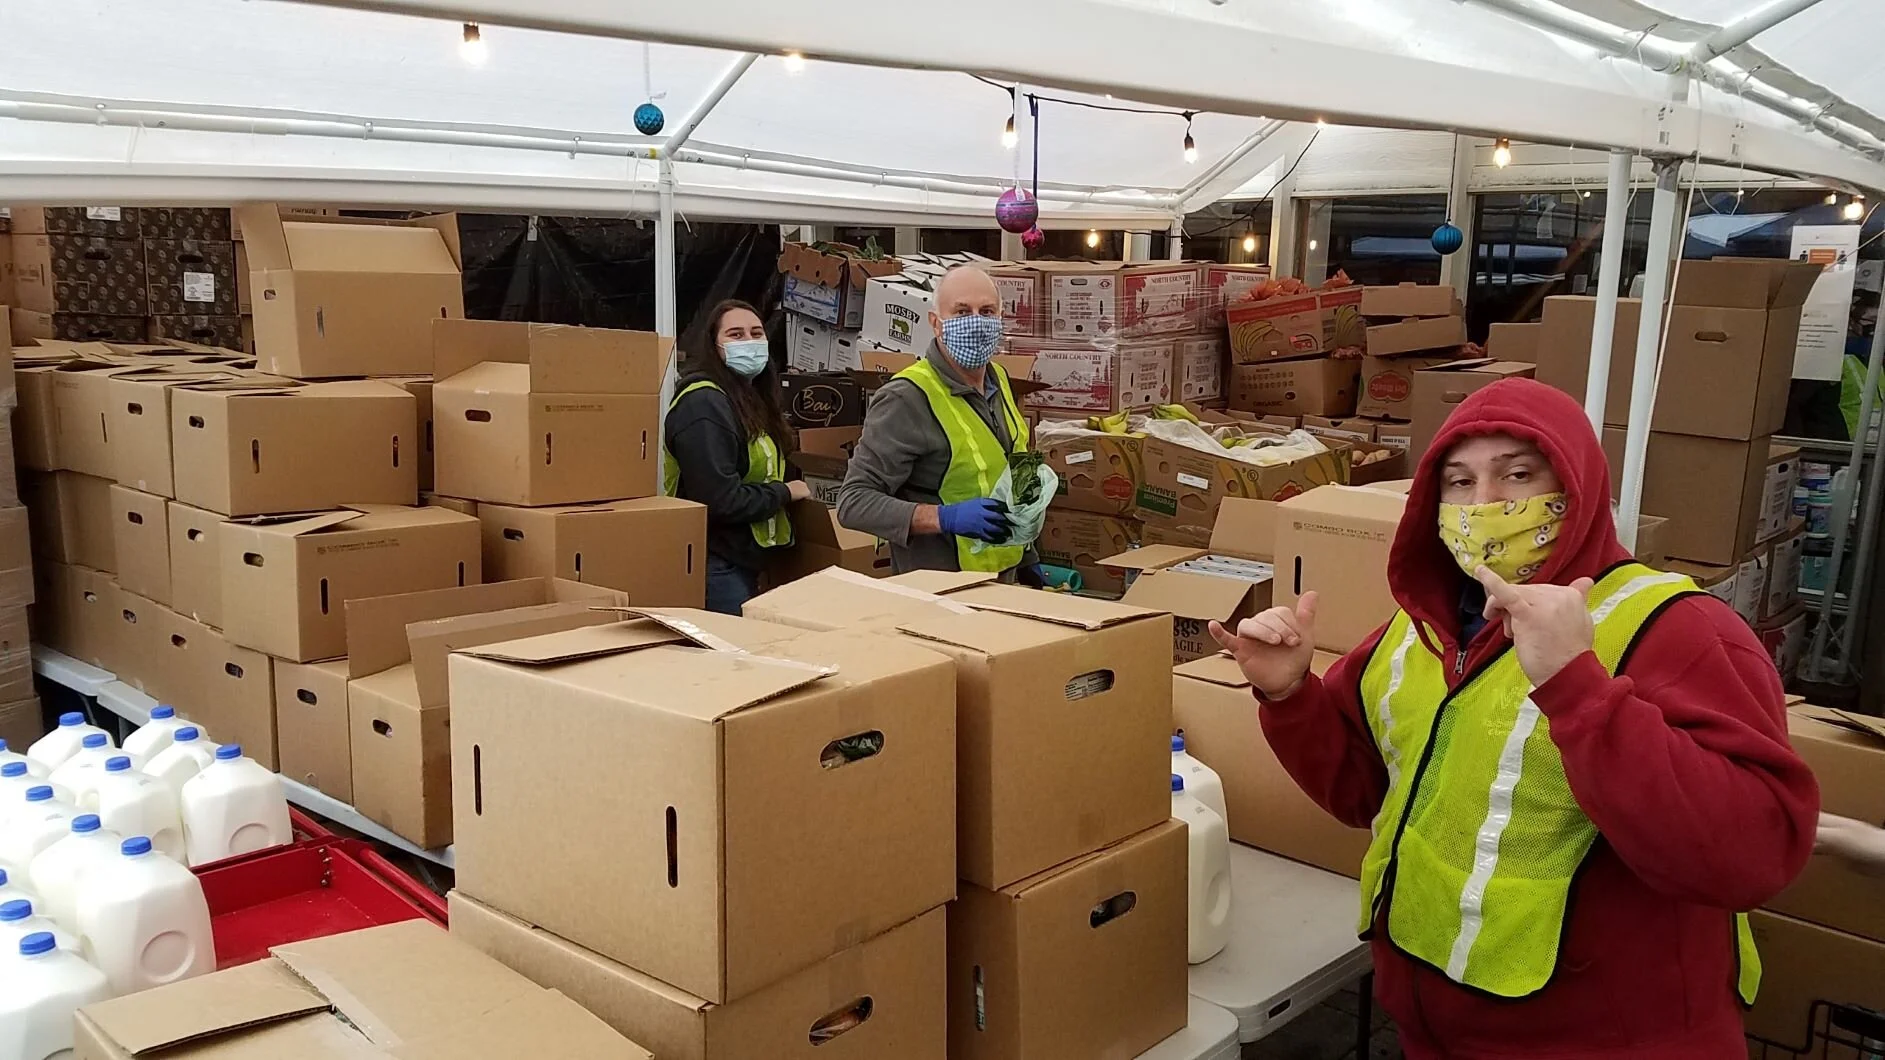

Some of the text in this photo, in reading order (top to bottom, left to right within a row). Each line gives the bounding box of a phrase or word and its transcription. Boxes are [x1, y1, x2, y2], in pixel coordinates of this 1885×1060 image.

[997, 279, 1026, 288] COUNTRY
[886, 304, 919, 323] MOSBY
[890, 330, 911, 342] FARMS
[1070, 353, 1101, 361] COUNTRY
[815, 483, 838, 502] Mar
[1143, 493, 1175, 508] Premium
[1173, 620, 1200, 638] ggs
[1173, 640, 1203, 655] AGILE
